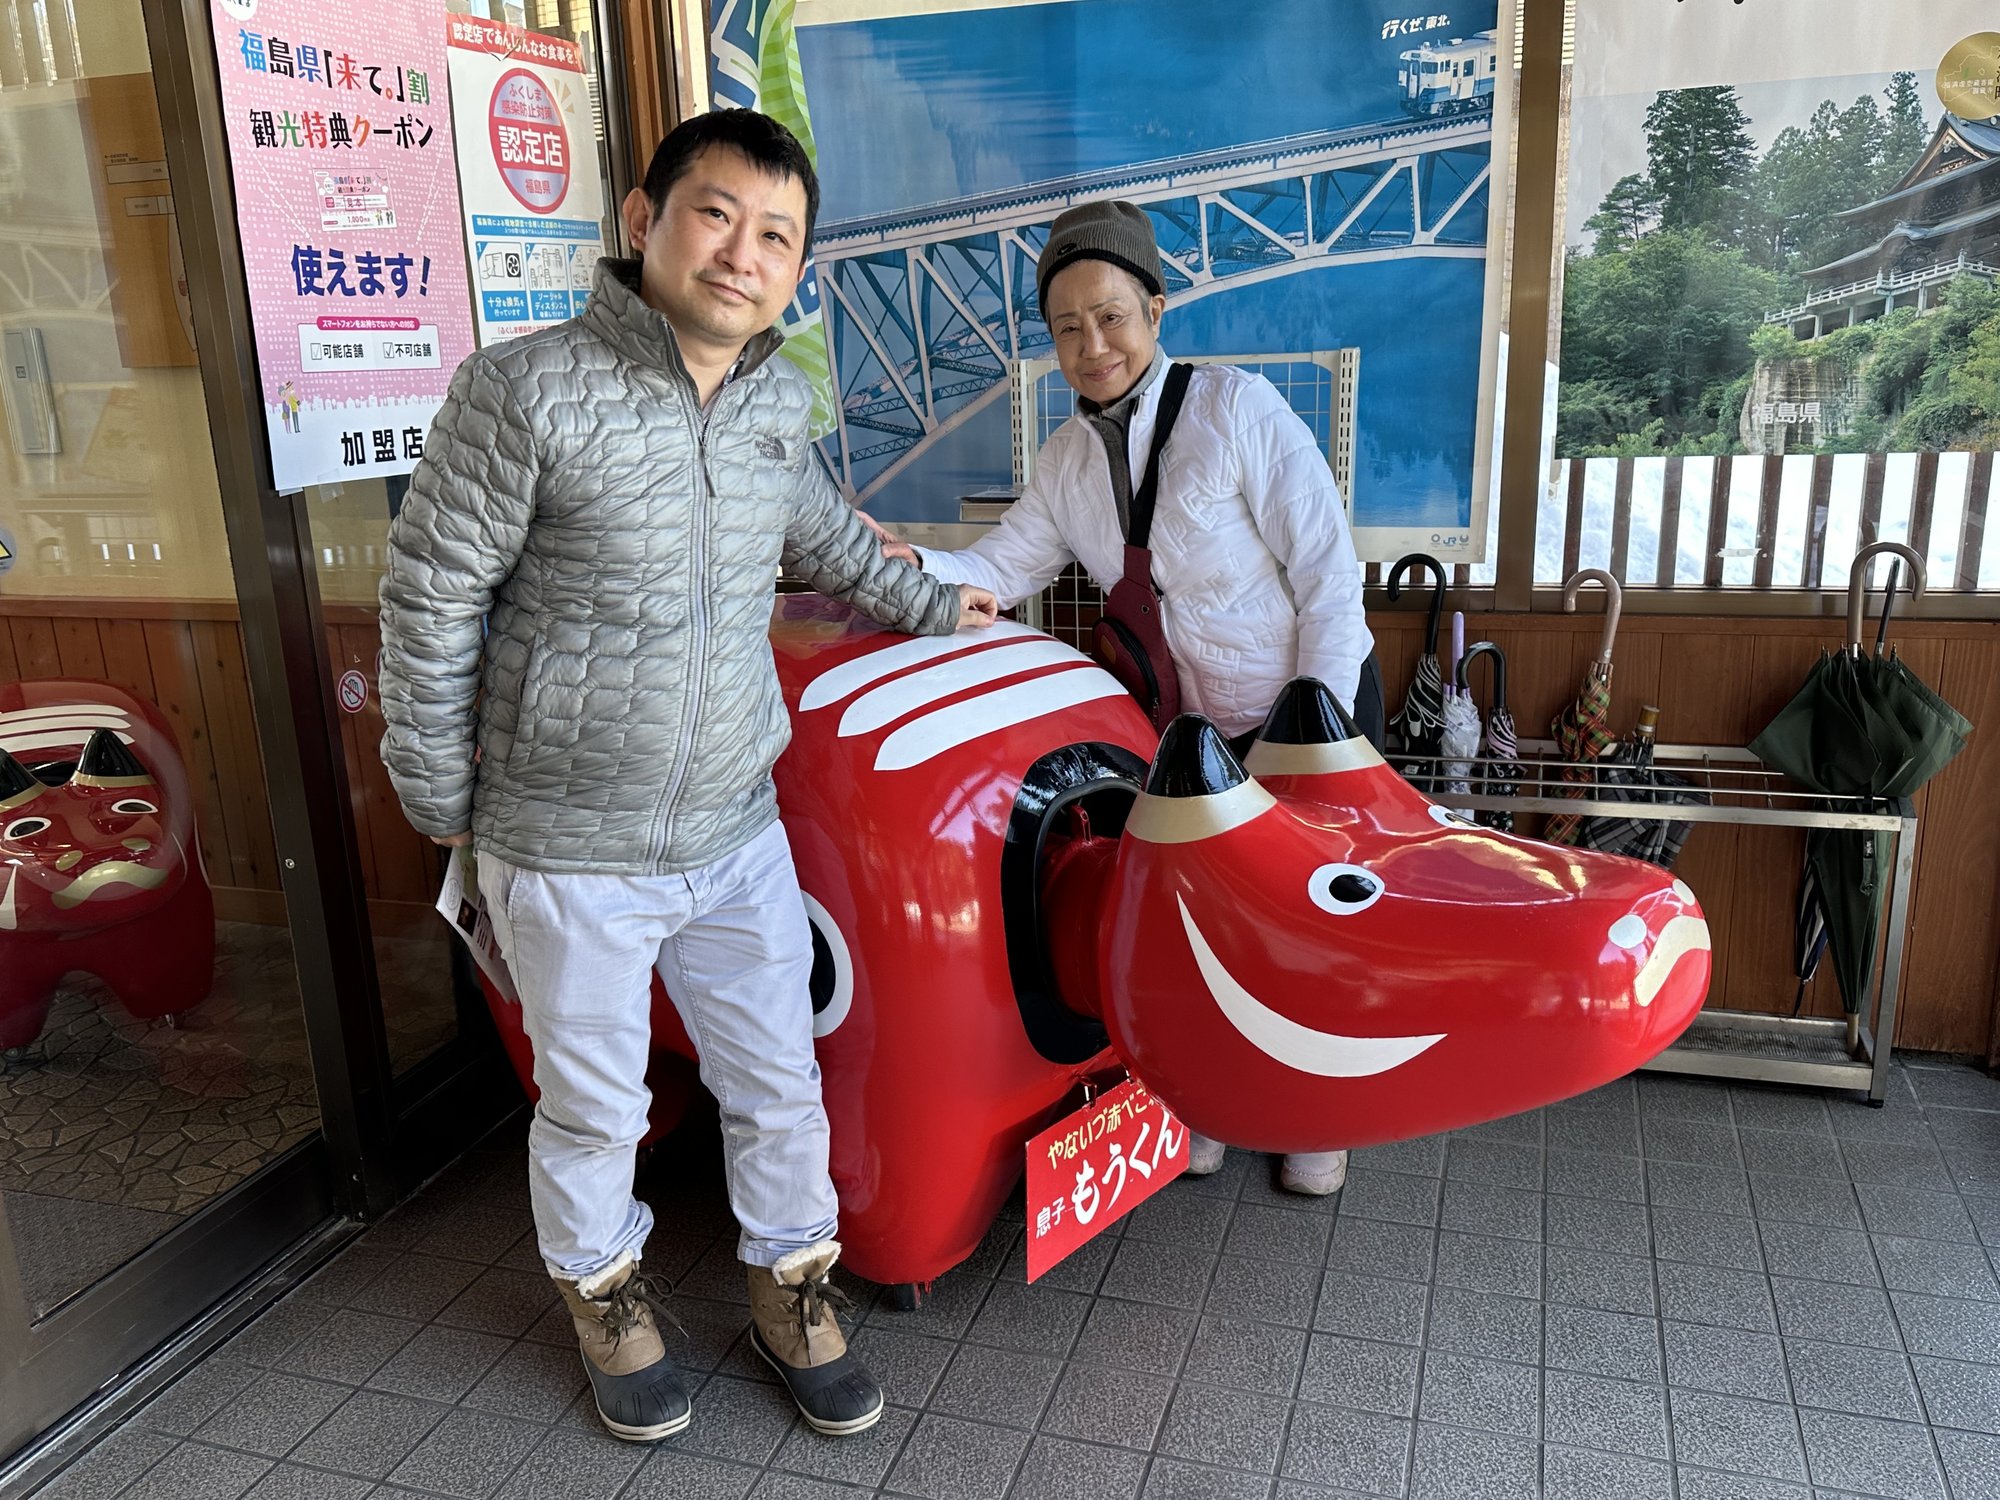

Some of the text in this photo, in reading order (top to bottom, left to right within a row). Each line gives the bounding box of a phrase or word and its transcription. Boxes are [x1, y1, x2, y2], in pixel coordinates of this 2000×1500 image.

[1382, 15, 1450, 39] 行くぜ、東北。
[239, 28, 430, 107] 福島県「来て。」割
[509, 83, 542, 102] ふくしま
[250, 108, 434, 149] 観光特典クーポン
[498, 125, 564, 168] 認定店
[525, 177, 552, 195] 福島県
[477, 243, 483, 253] 1
[526, 244, 532, 255] 2
[568, 246, 574, 255] 3
[291, 243, 431, 298] 使えます！
[322, 343, 364, 359] 可能店舗
[394, 343, 432, 357] 不可店舗
[1751, 401, 1822, 424] 福島県
[341, 426, 424, 467] 加盟店
[1443, 536, 1457, 545] JR
[1047, 1087, 1155, 1170] やないづ赤べこ
[1036, 1107, 1185, 1239] 息子 もうくん
